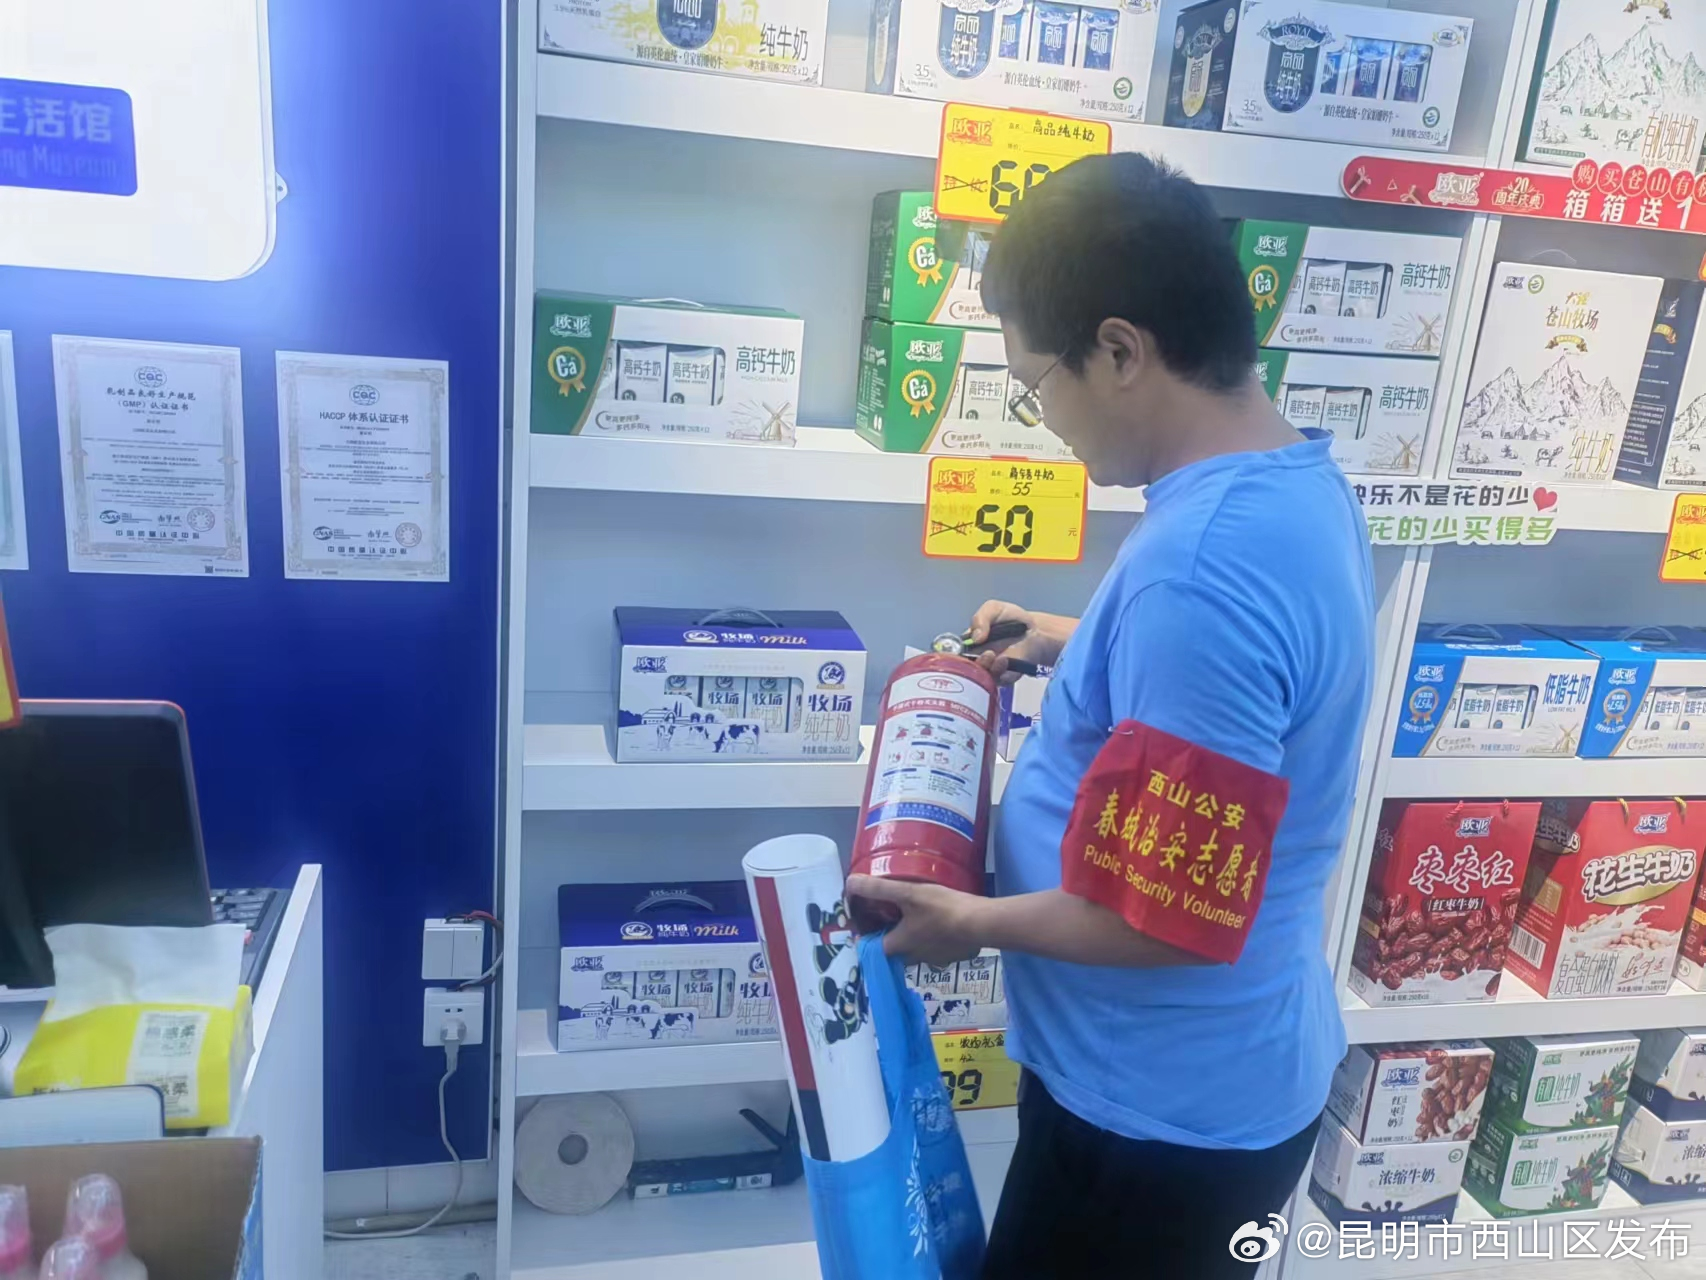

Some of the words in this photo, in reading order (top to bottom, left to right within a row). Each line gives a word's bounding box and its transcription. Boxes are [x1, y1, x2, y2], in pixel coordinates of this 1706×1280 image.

[953, 14, 980, 35] 高品
[1282, 25, 1311, 38] ROYAL
[760, 22, 808, 61] 纯牛奶
[950, 34, 977, 67] 纯牛奶
[1281, 52, 1305, 70] 高品
[952, 118, 992, 140] 欧亚
[1437, 174, 1480, 194] 欧亚
[1514, 177, 1529, 193] 20
[1495, 192, 1541, 209] 周年庆典
[1258, 236, 1287, 250] 欧亚
[1308, 276, 1340, 292] 高钙牛奶
[1400, 263, 1451, 289] 高钙牛奶
[1348, 279, 1379, 295] 高钙牛奶
[554, 314, 590, 332] 欧亚
[1546, 305, 1599, 331] 苍山牧场
[910, 340, 943, 356] 欧亚
[556, 355, 577, 377] Ca
[624, 359, 661, 377] 高钙牛奶
[736, 346, 796, 375] 高钙牛奶
[138, 372, 163, 382] CQC
[673, 362, 710, 379] 高钙牛奶
[353, 391, 376, 400] CQC
[909, 377, 928, 399] Ca
[969, 380, 1002, 396] 高钙牛奶
[1379, 385, 1429, 410] 高钙牛奶
[1289, 400, 1320, 416] 高钙牛奶
[1327, 402, 1358, 418] 高钙牛奶
[319, 411, 345, 420] HACCP
[349, 413, 409, 424] 体系认证证书
[938, 469, 977, 488] 欧亚
[1011, 481, 1032, 496] 55
[975, 504, 1033, 554] 50
[1068, 527, 1077, 537] 元
[1368, 515, 1554, 542] 花的少买得多
[636, 656, 667, 671] 欧亚
[1542, 673, 1592, 705] 低脂牛奶
[708, 692, 739, 705] 牧场
[752, 692, 783, 706] 牧场
[808, 694, 852, 712] 牧场
[1463, 699, 1491, 712] 低脂牛奶
[1496, 699, 1524, 712] 低脂牛奶
[804, 713, 851, 742] 纯牛奶
[1147, 769, 1246, 831] 西山公安
[1461, 817, 1491, 833] 欧亚
[1639, 814, 1668, 832] 欧亚
[1409, 845, 1514, 894] 枣枣红
[1582, 849, 1696, 903] 花生牛奶
[1084, 845, 1121, 875] Public
[1125, 864, 1176, 908] Security
[1183, 892, 1246, 929] Volunteer
[1432, 897, 1480, 911] 红枣牛奶
[573, 955, 604, 970] 欧亚
[924, 972, 950, 984] 牧场
[963, 970, 990, 981] 牧场
[641, 984, 671, 995] 牧场
[684, 982, 714, 994] 牧场
[960, 1054, 975, 1063] 42
[1386, 1067, 1420, 1084] 欧亚
[1360, 1152, 1384, 1165] 欧亚
[1379, 1168, 1435, 1186] 浓缩牛奶
